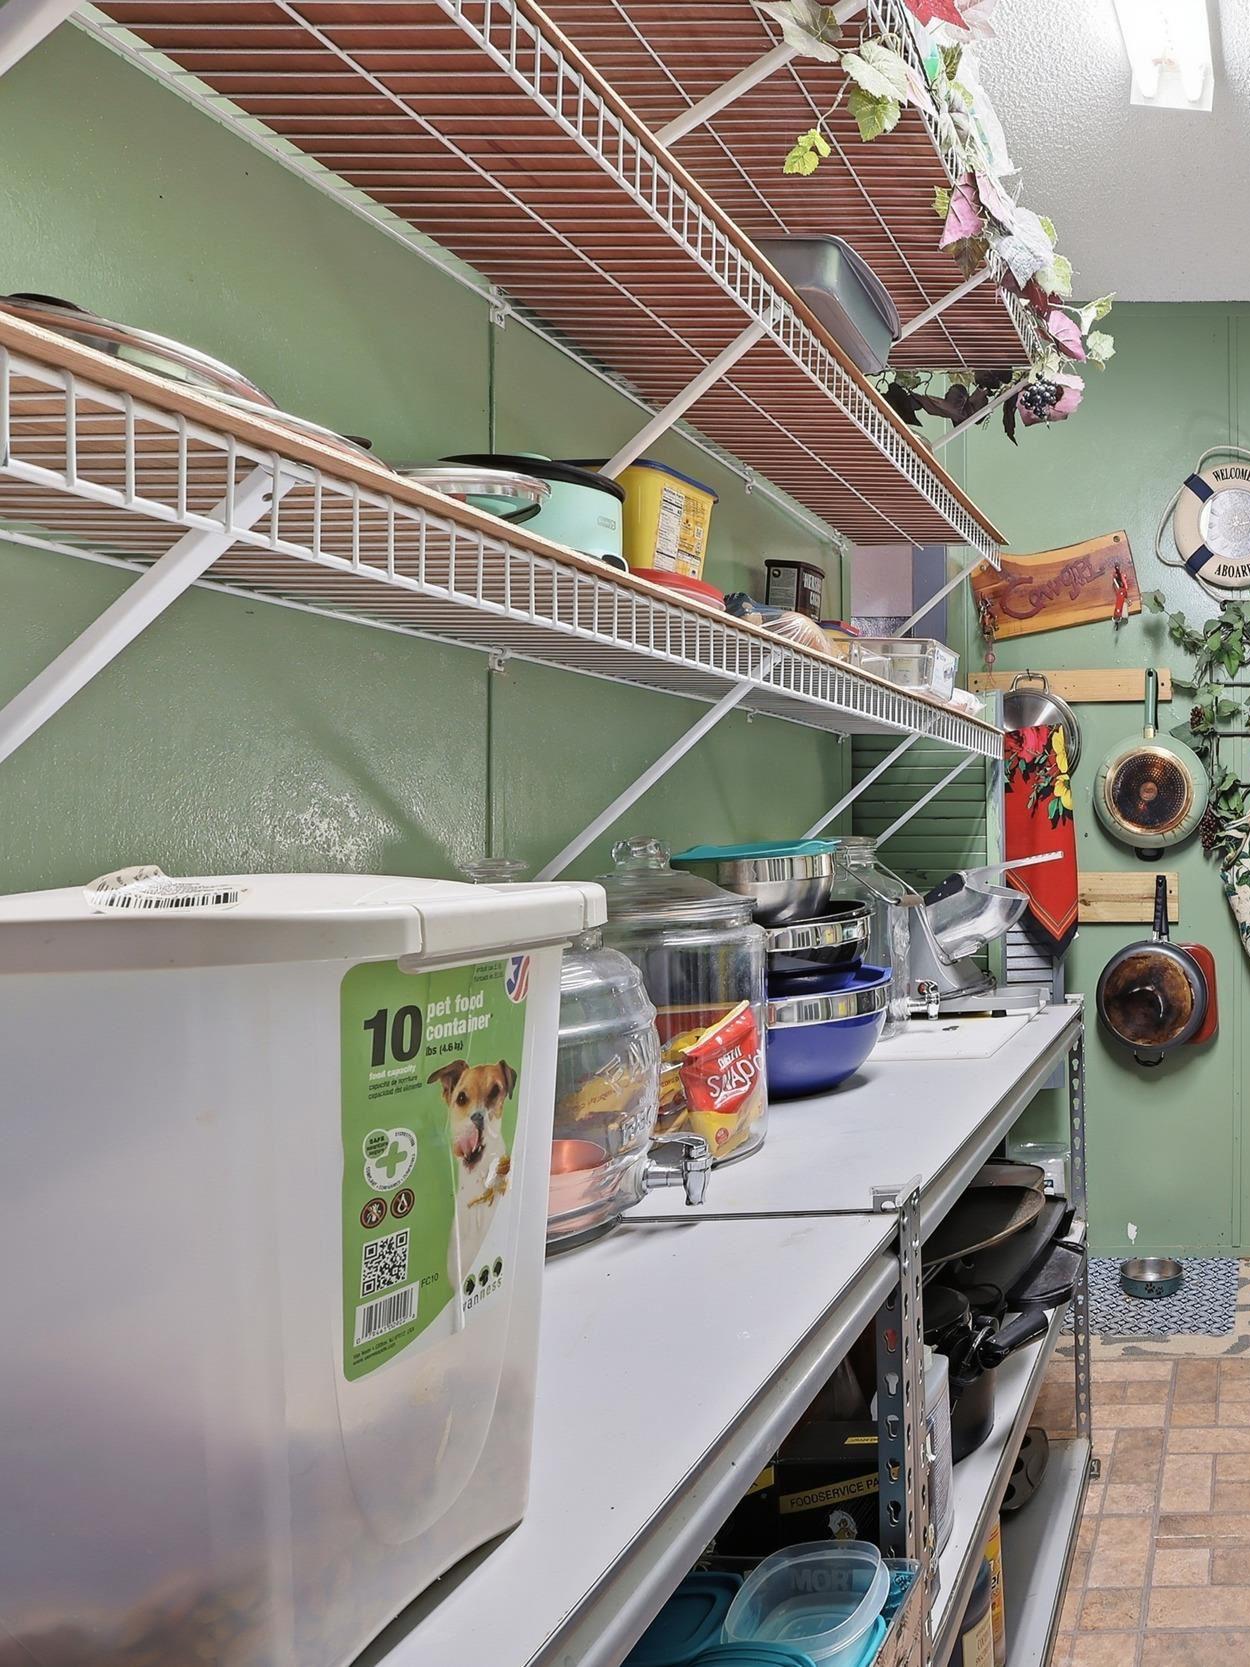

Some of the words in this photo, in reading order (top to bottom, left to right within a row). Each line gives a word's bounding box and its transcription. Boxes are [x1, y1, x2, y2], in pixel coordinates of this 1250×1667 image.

[427, 996, 451, 1024] pet
[455, 990, 484, 1013] food
[363, 1005, 423, 1068] 10
[426, 1013, 491, 1042] container
[420, 1272, 439, 1289] FC10
[462, 1276, 503, 1312] vanness
[790, 1482, 864, 1509] FOODSERVICE
